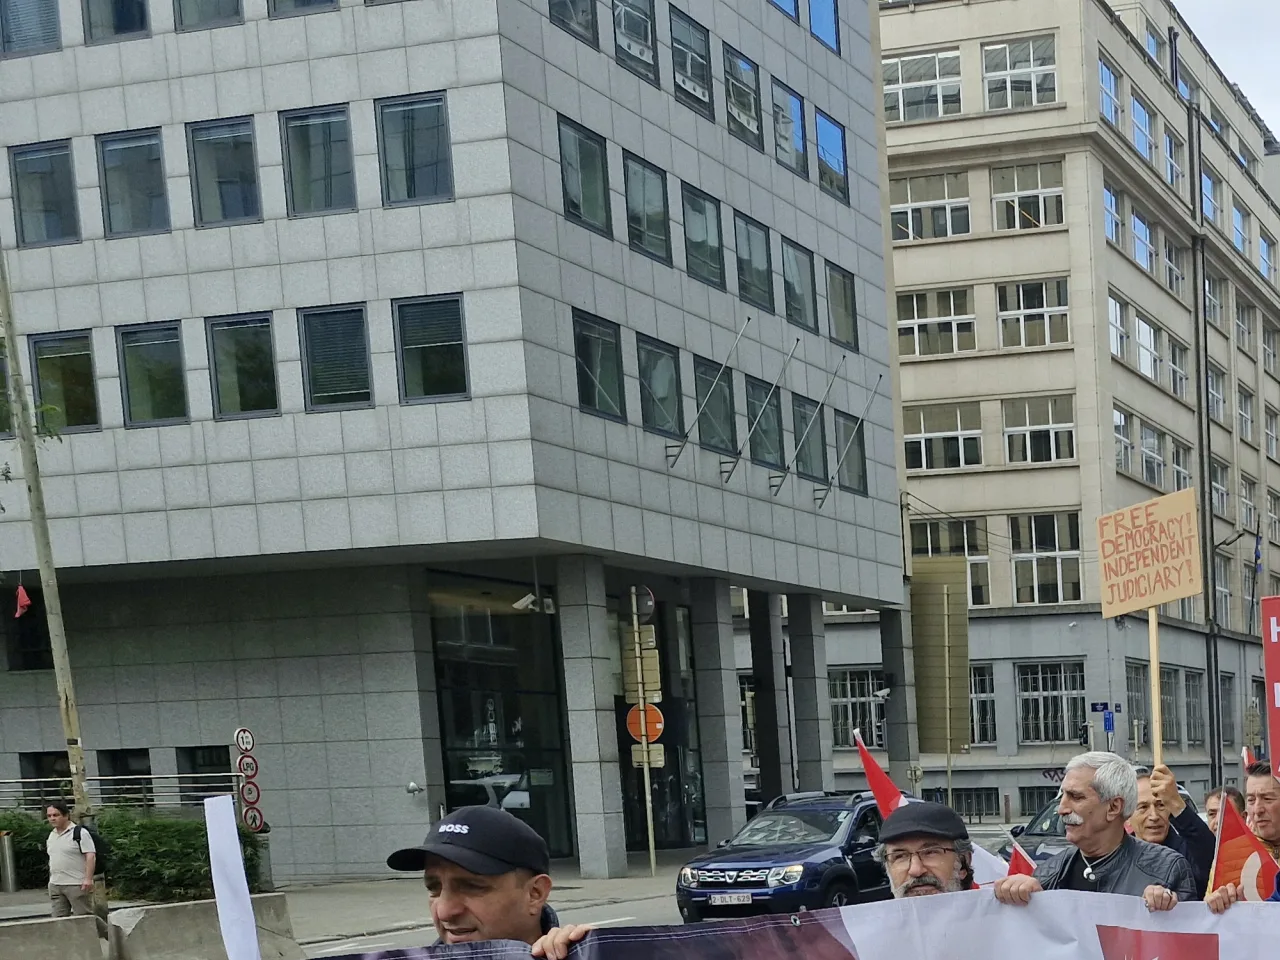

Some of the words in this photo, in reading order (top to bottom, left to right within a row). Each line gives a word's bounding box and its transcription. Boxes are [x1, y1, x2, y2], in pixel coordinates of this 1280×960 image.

[1098, 502, 1160, 539] FREE
[1100, 512, 1192, 559] DEMOCRACY!
[1103, 534, 1196, 581] INDEPENDENT
[1105, 559, 1194, 605] JUDICIARY!
[242, 762, 254, 771] LPG
[438, 823, 470, 834] BOSS
